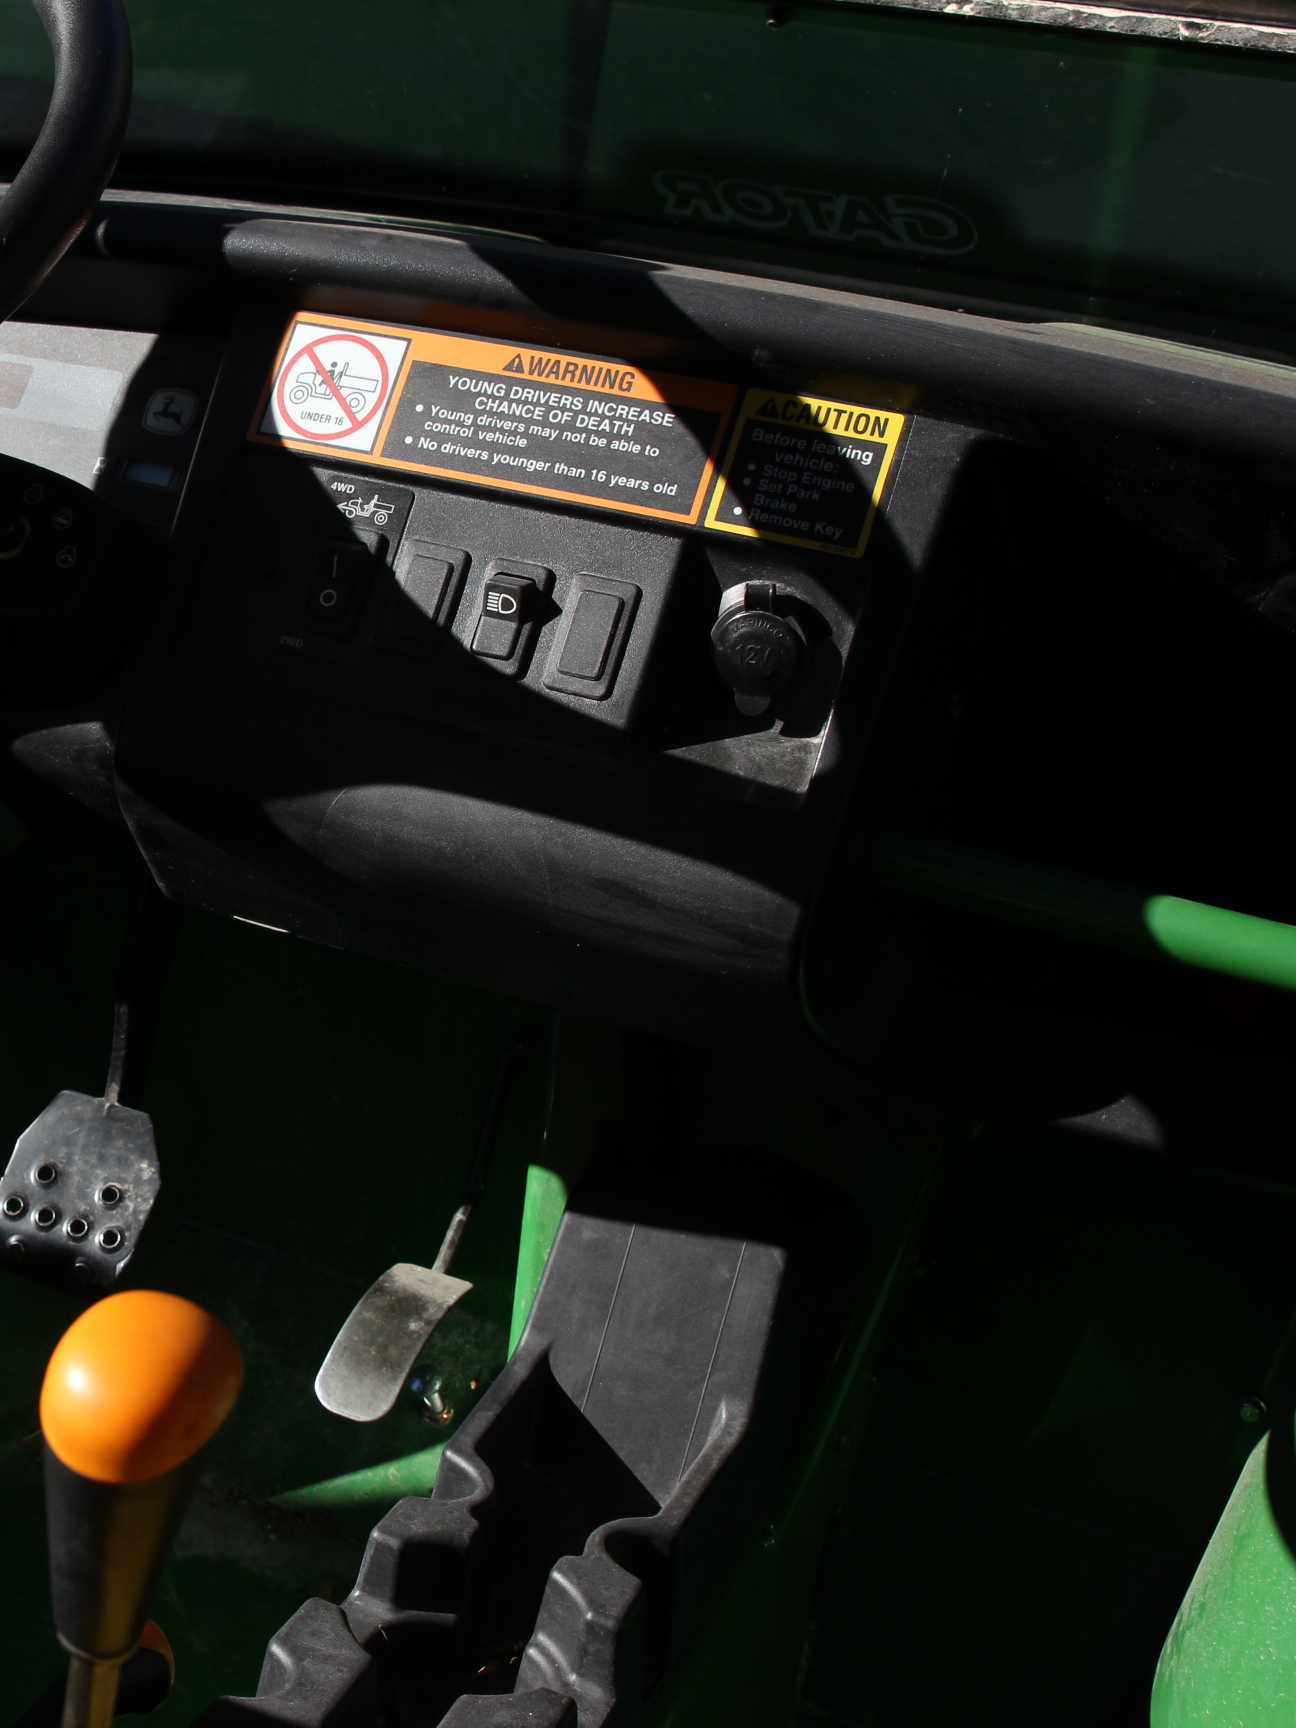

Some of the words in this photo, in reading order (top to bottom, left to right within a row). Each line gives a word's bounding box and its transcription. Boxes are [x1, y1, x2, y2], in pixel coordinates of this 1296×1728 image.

[528, 355, 635, 393] WARNING
[448, 375, 506, 397] YOUNG
[509, 386, 583, 410] DRIVERS
[586, 400, 675, 427] INCREASE
[300, 410, 332, 424] UNDER
[334, 416, 344, 426] 16
[430, 404, 474, 425] Young
[476, 414, 525, 432] drivers
[528, 425, 559, 441] may
[562, 431, 586, 444] not
[589, 434, 607, 447] be
[610, 439, 641, 454] able
[644, 445, 660, 457] to
[474, 397, 545, 420] CHANCE
[548, 410, 573, 425] OF
[576, 414, 635, 437] DEATH
[781, 400, 890, 438] CAUTION
[424, 421, 474, 438] control
[478, 431, 528, 448] vehicle
[751, 428, 807, 450] Before
[811, 439, 874, 466] leaving
[417, 437, 438, 451] No
[441, 442, 489, 460] drivers
[491, 452, 551, 472] younger
[553, 462, 586, 478] than
[590, 468, 606, 482] 16
[609, 474, 649, 491] years
[653, 482, 678, 496] old
[775, 451, 839, 473] vehicle:
[330, 481, 355, 494] 4WD
[757, 479, 784, 494] Set
[786, 484, 821, 502] Park
[762, 464, 797, 483] Stop
[801, 472, 855, 493] Engine
[754, 494, 797, 513] Brake
[748, 508, 810, 531] Remove
[814, 520, 843, 540] Key
[279, 635, 304, 648] 2WD
[735, 644, 772, 665] 12V
